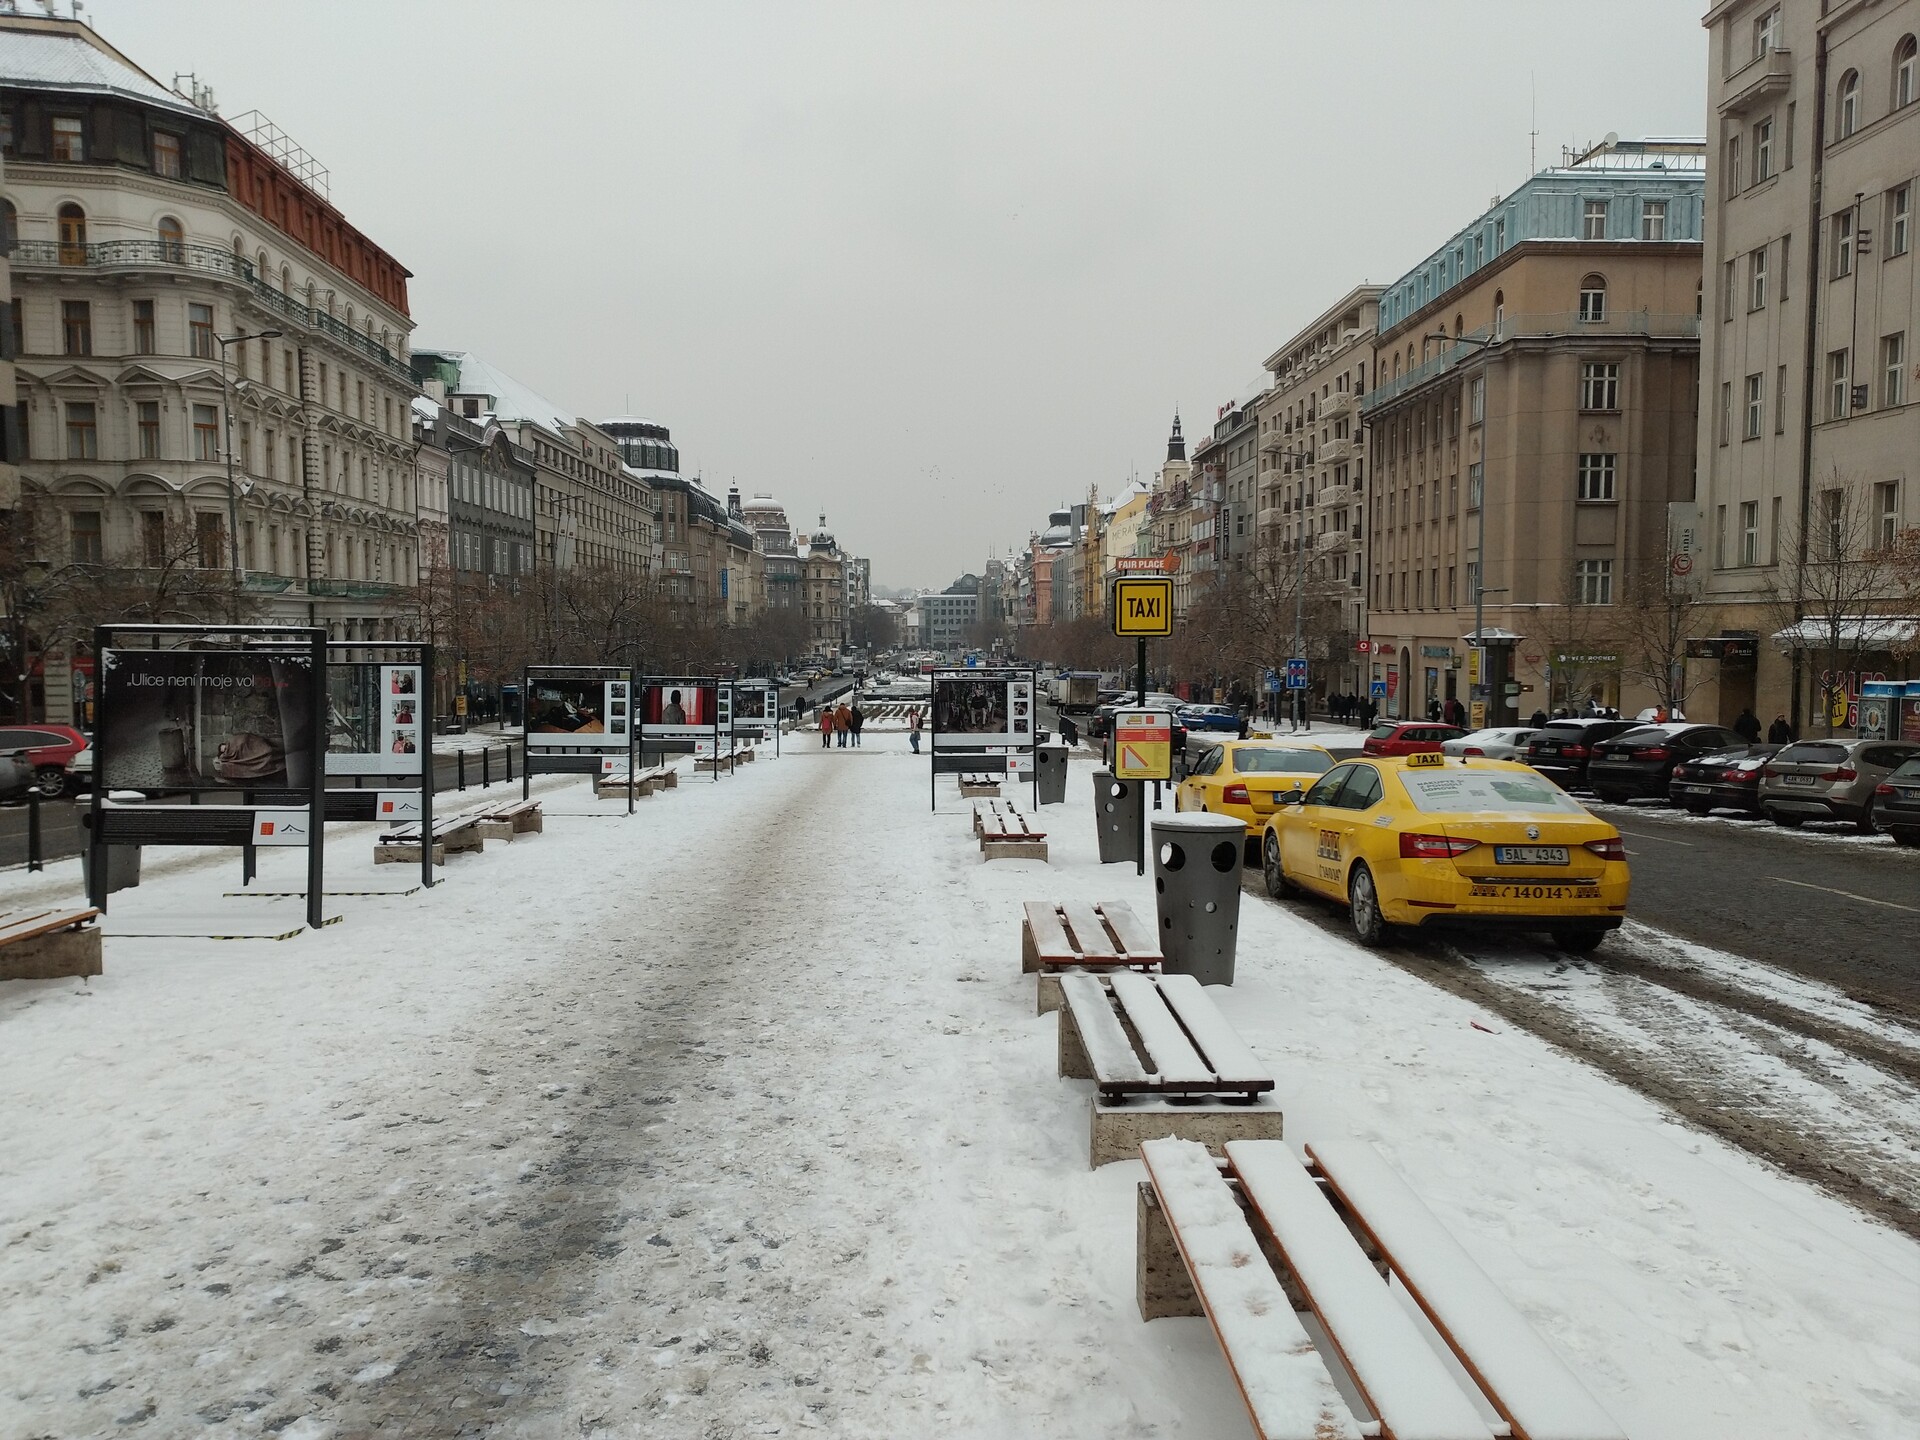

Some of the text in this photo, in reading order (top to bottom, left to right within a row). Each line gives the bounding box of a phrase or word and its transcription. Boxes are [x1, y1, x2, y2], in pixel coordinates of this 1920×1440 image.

[1118, 560, 1164, 569] FAIR PLACE
[1126, 597, 1160, 618] TAXI
[167, 673, 198, 687] není
[199, 673, 232, 690] moje
[1821, 669, 1886, 703] SAL
[1415, 754, 1440, 764] TAXI
[1505, 848, 1564, 861] 5AL 4343
